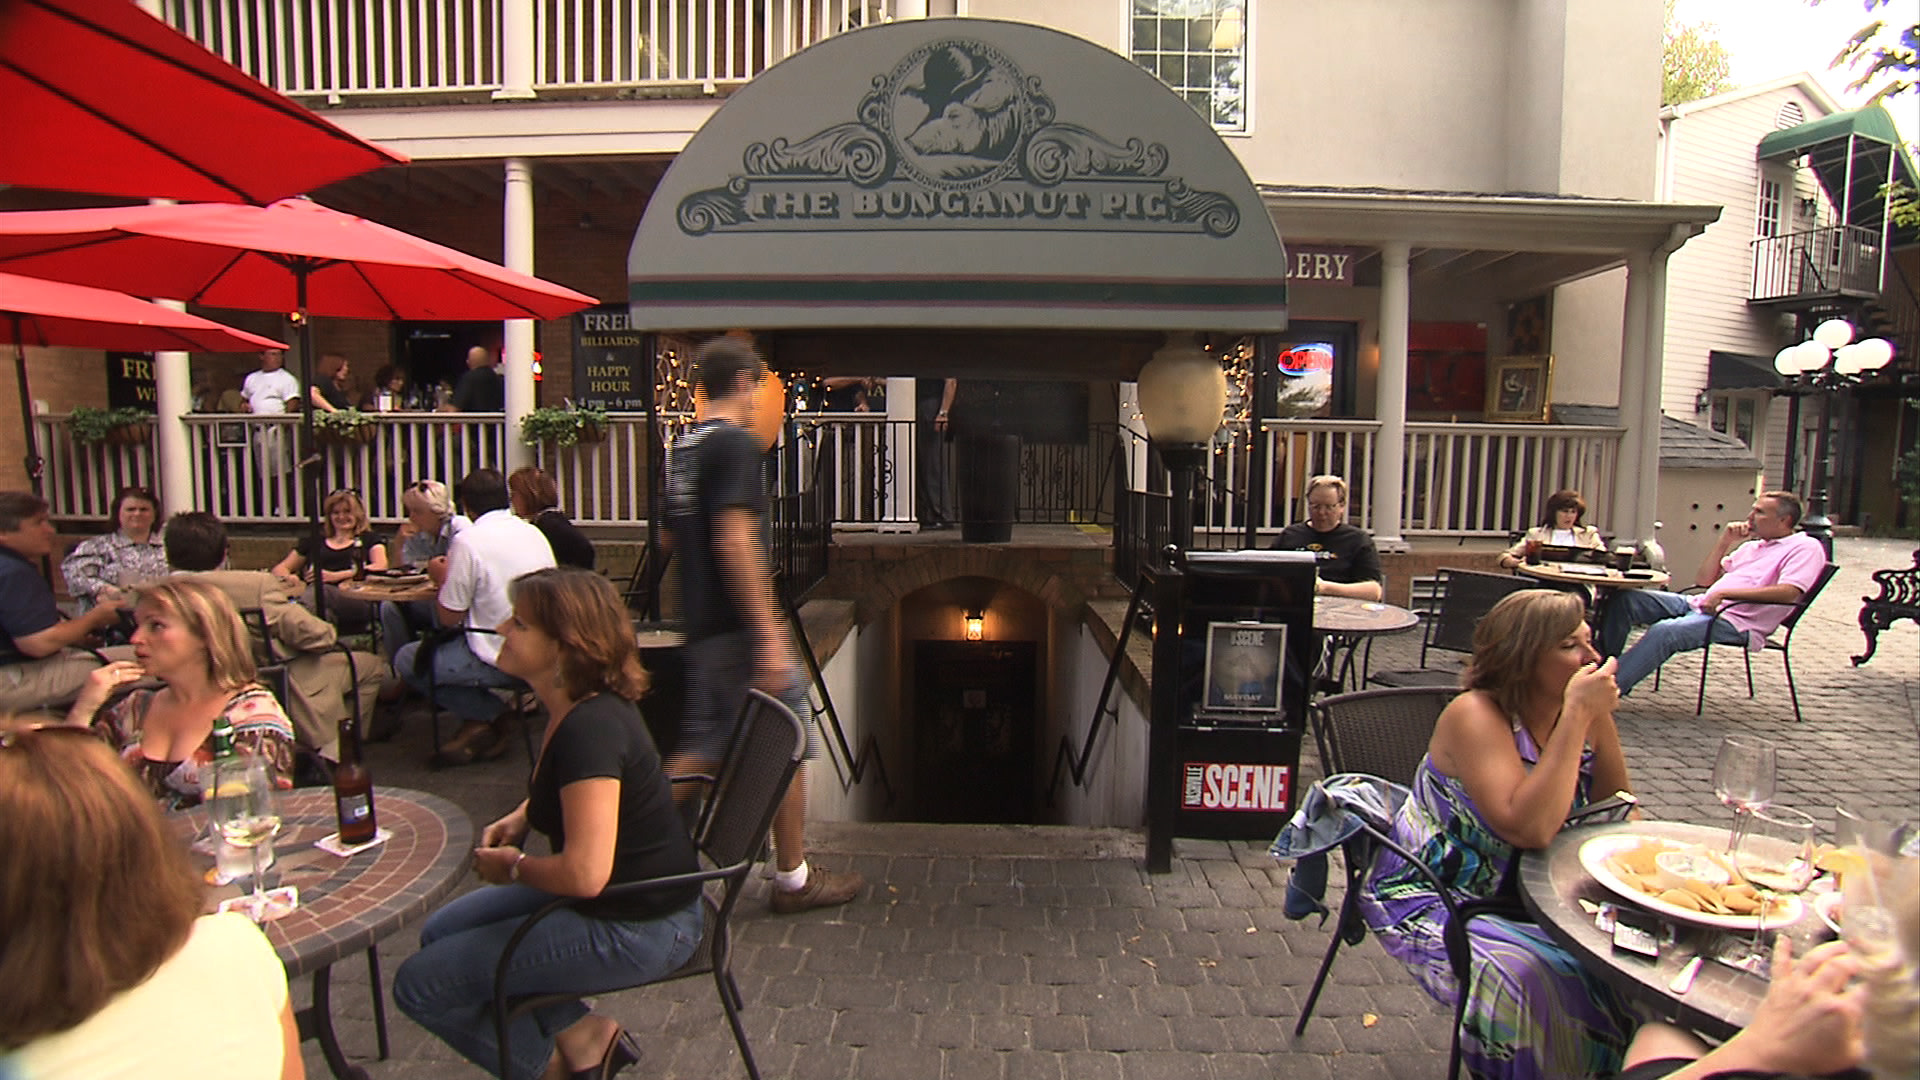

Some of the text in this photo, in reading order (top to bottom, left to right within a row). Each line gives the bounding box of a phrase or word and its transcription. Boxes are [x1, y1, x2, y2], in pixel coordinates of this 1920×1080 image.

[748, 191, 1168, 219] THE BUNGANUT PIG
[580, 335, 641, 348] BILLIARDS
[1278, 350, 1333, 370] OPEN
[587, 366, 631, 377] HAPPY
[591, 380, 631, 392] HOUR
[616, 397, 623, 408] 6
[625, 400, 642, 410] pm
[1203, 764, 1288, 808] SCENE
